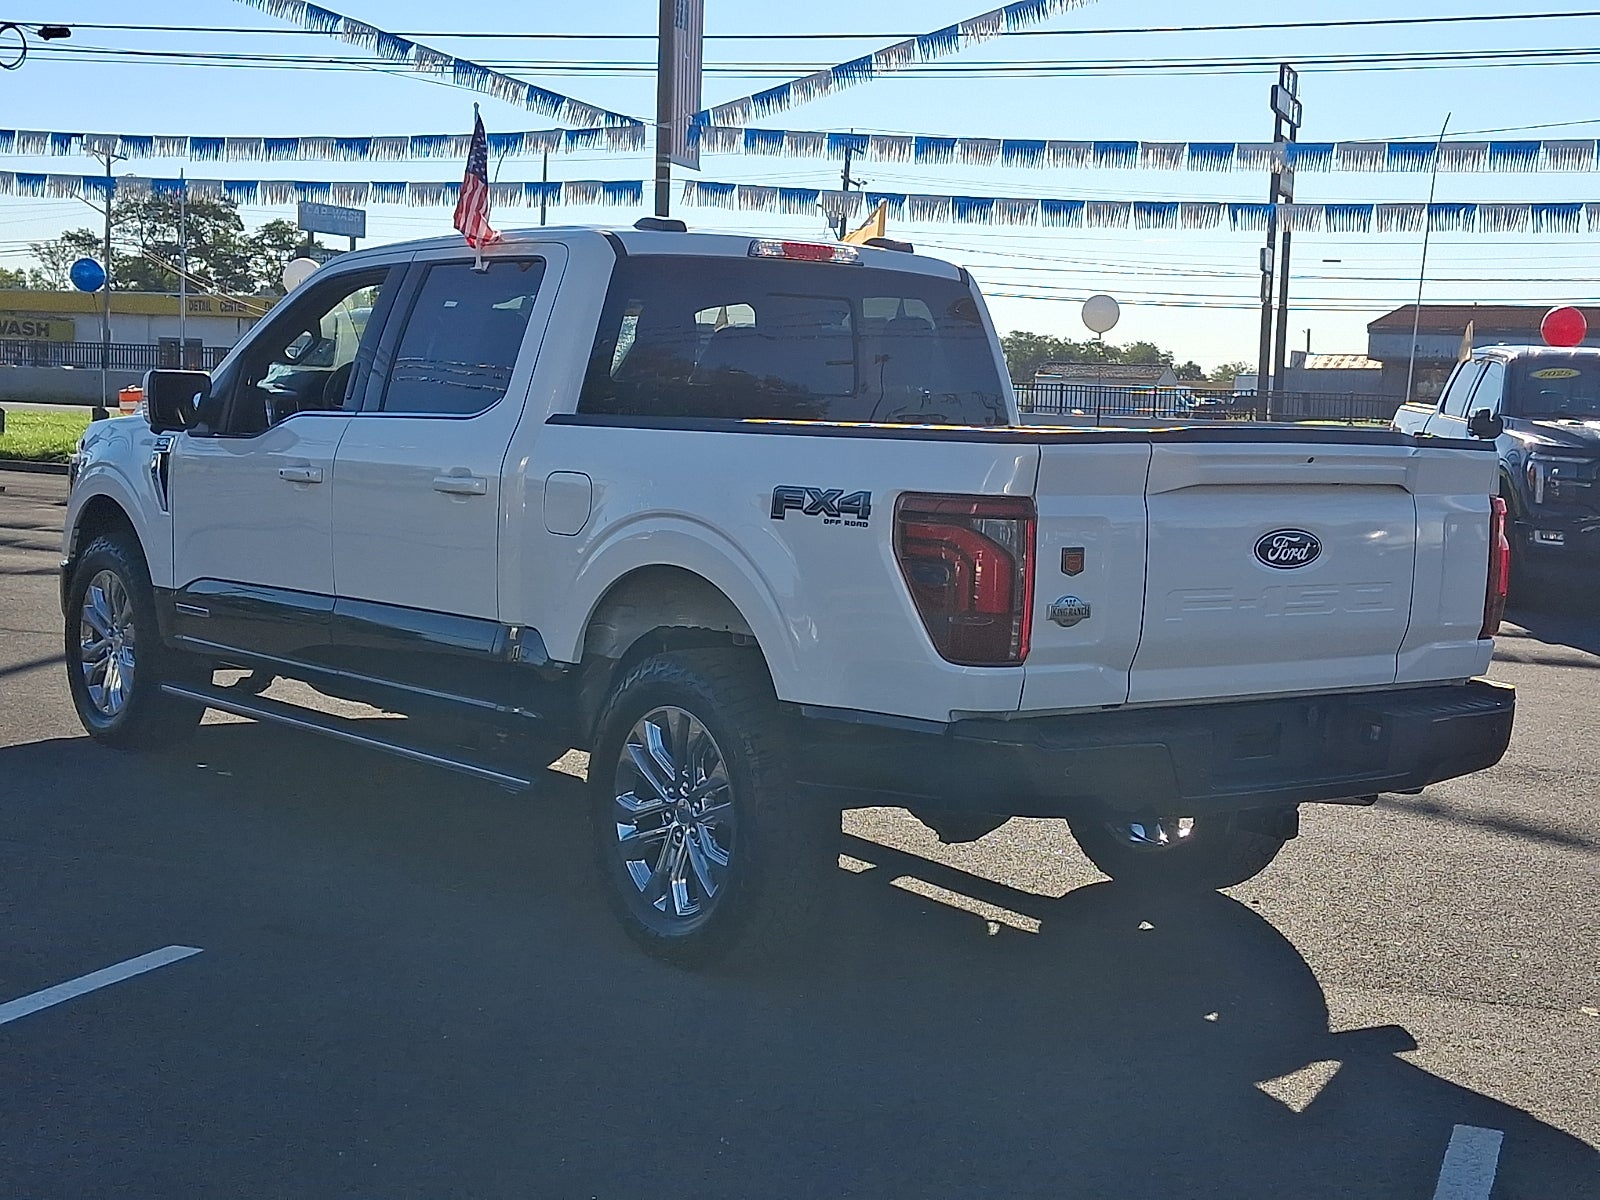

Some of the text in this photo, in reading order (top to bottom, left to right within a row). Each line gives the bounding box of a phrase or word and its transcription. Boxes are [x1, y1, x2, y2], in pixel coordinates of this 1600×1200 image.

[188, 300, 212, 312] DETAIL
[770, 485, 872, 520] FX4
[844, 520, 869, 528] ROAD
[1268, 535, 1310, 561] Ford
